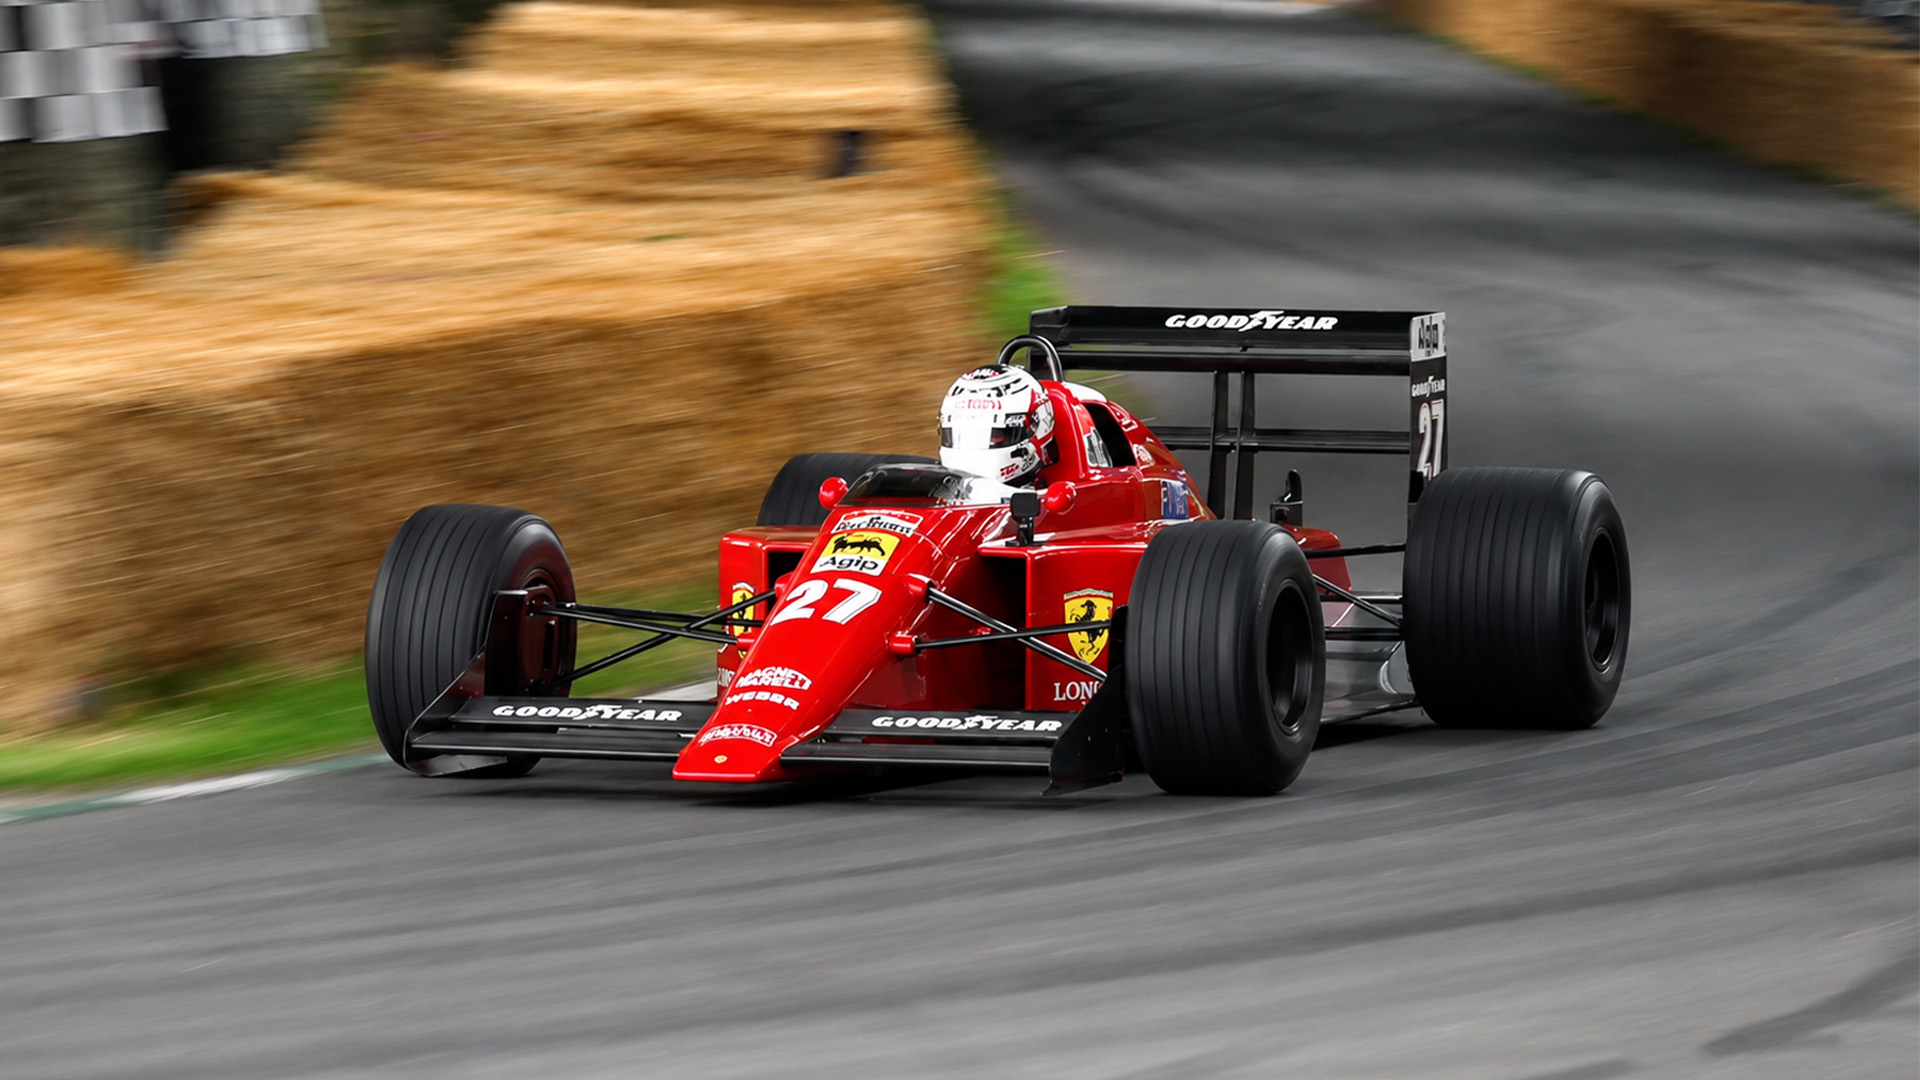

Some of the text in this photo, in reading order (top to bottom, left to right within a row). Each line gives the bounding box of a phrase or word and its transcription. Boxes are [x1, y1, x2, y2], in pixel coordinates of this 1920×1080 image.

[1164, 310, 1339, 332] GOODYEAR
[1416, 398, 1445, 480] 27
[819, 556, 879, 571] Agip
[769, 578, 883, 627] 27
[492, 704, 683, 721] GOODYEAR
[871, 715, 1063, 732] GOODYEAR
